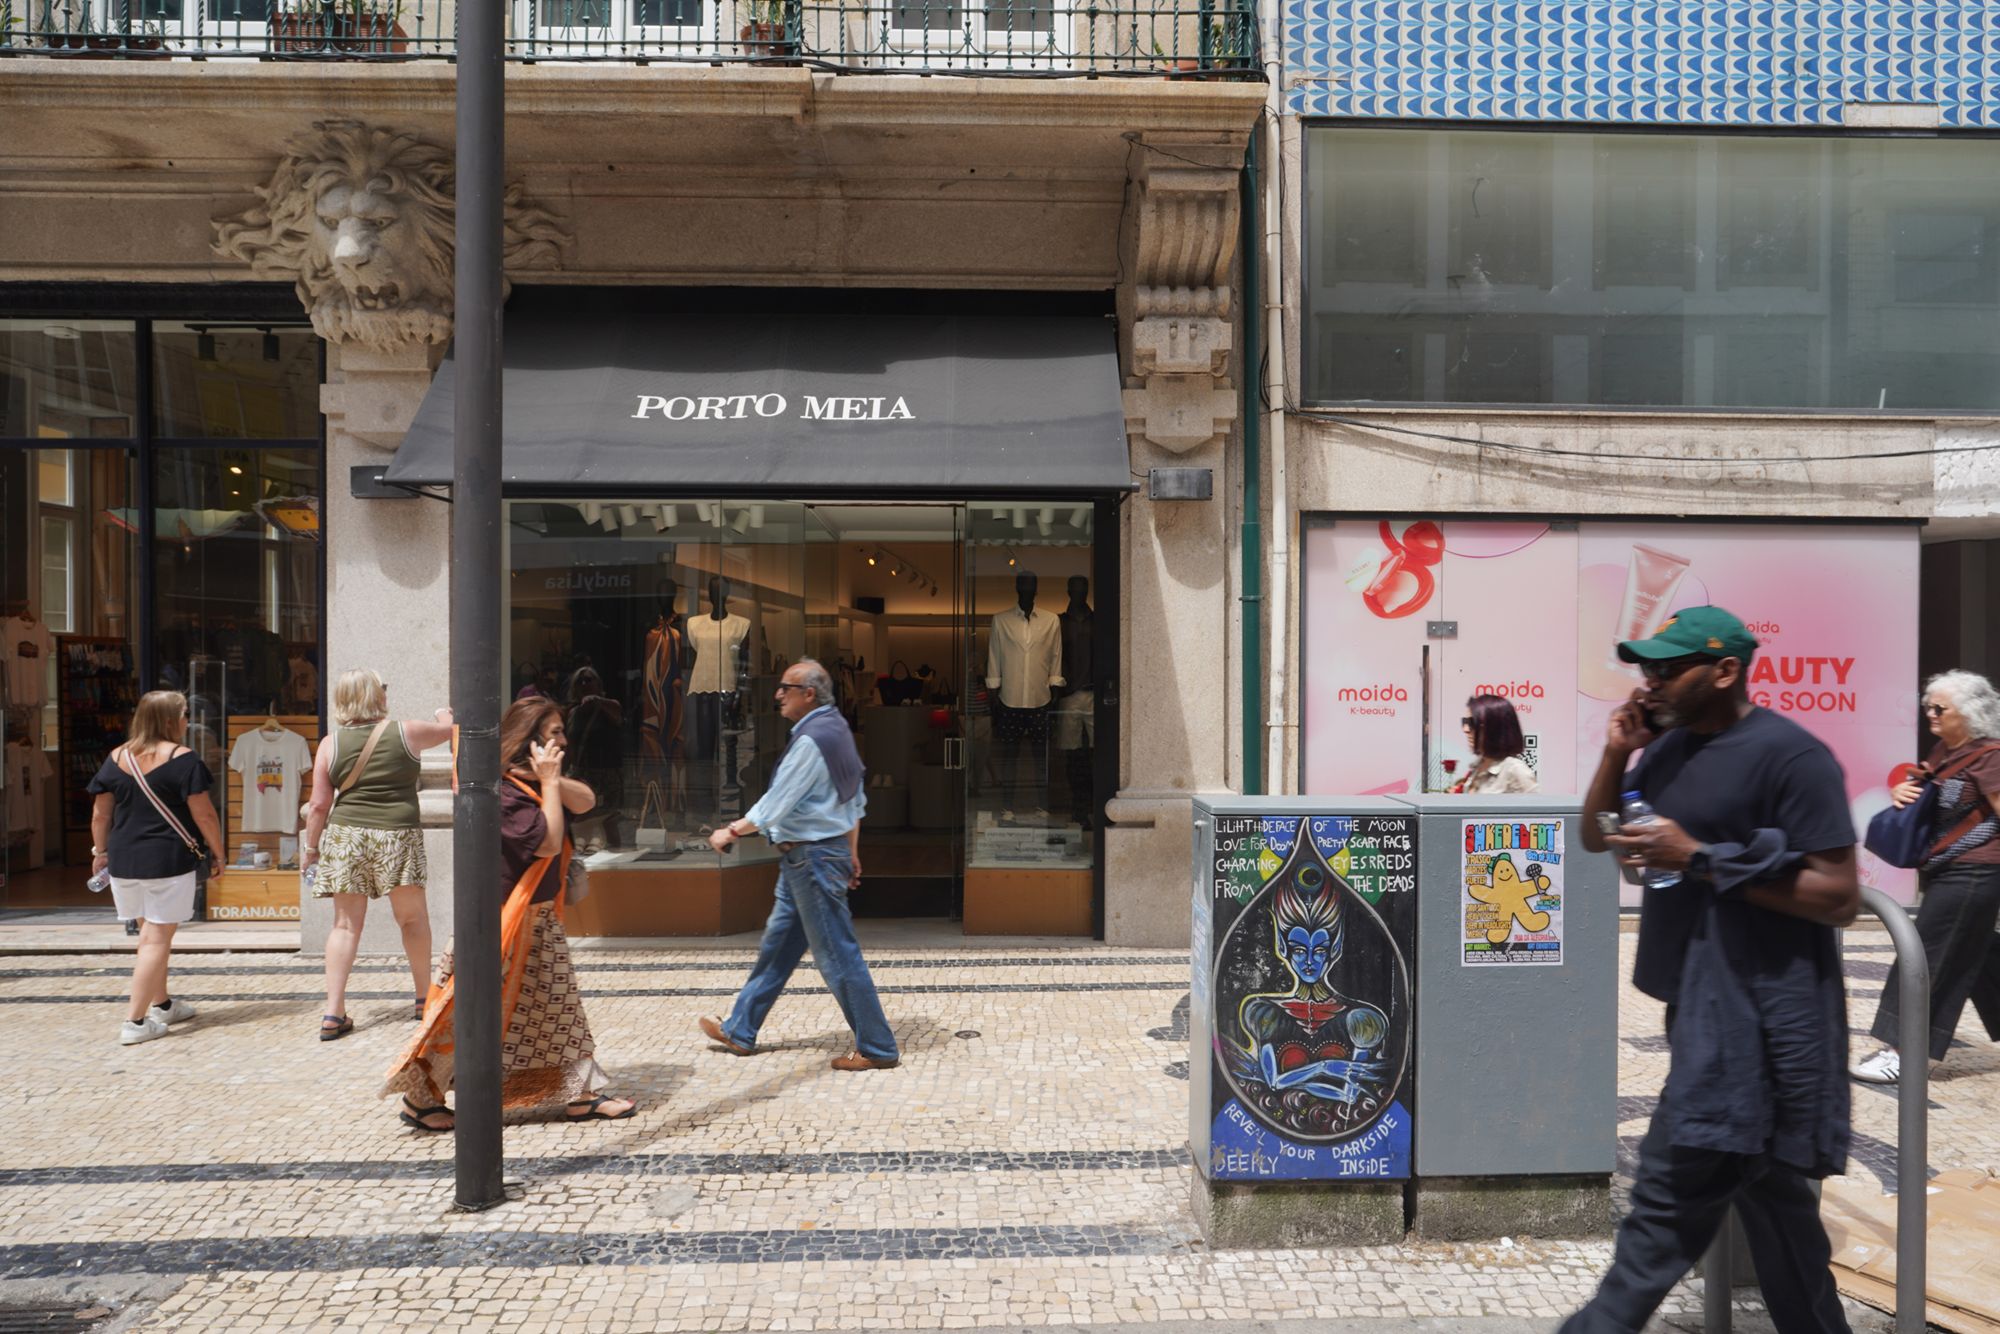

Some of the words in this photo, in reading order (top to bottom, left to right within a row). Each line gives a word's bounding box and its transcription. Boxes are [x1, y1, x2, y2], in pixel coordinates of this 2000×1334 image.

[631, 393, 787, 420] PORTO
[800, 395, 916, 420] MEIA
[1746, 620, 1780, 634] oida
[1750, 656, 1856, 685] AUTY
[1338, 683, 1408, 701] moida
[1474, 680, 1544, 699] moida
[1779, 690, 1856, 712] SOON
[1350, 706, 1396, 717] K-beauty
[1313, 820, 1330, 833] OF
[1336, 820, 1360, 832] THE
[1349, 836, 1380, 849] SCARY
[1214, 878, 1256, 899] FROM
[1346, 874, 1375, 892] THE
[1279, 1140, 1315, 1161] YOUR
